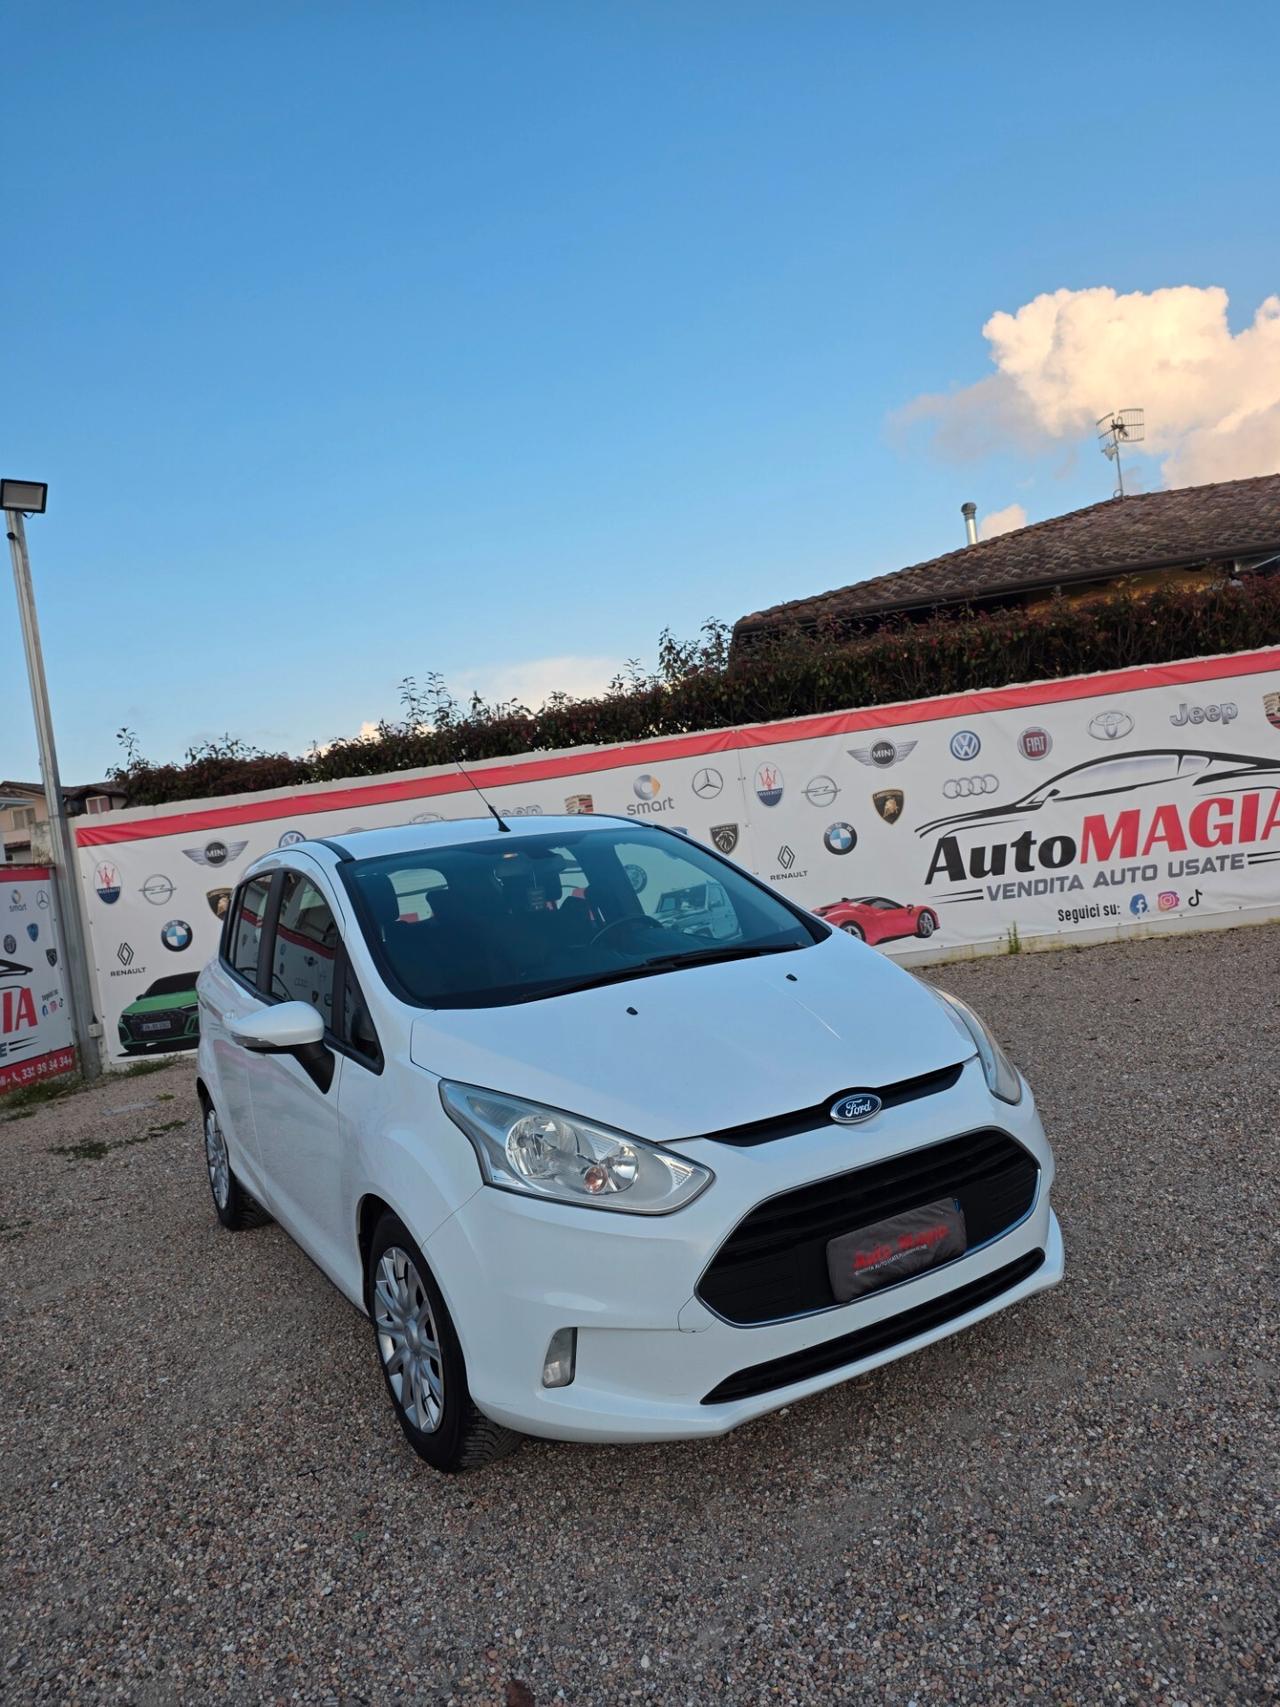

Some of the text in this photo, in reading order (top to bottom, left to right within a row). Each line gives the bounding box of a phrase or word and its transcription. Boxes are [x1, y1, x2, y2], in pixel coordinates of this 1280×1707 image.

[1168, 703, 1238, 726] Jeep
[1026, 736, 1045, 752] FIAT
[872, 749, 894, 758] MINI
[626, 797, 675, 815] smart
[770, 870, 808, 881] RENAULT
[986, 853, 1245, 901] VENDITA AUTO USATE
[1057, 903, 1121, 924] Seguici su:
[110, 967, 147, 977] RENAULT
[845, 1099, 872, 1117] Ford
